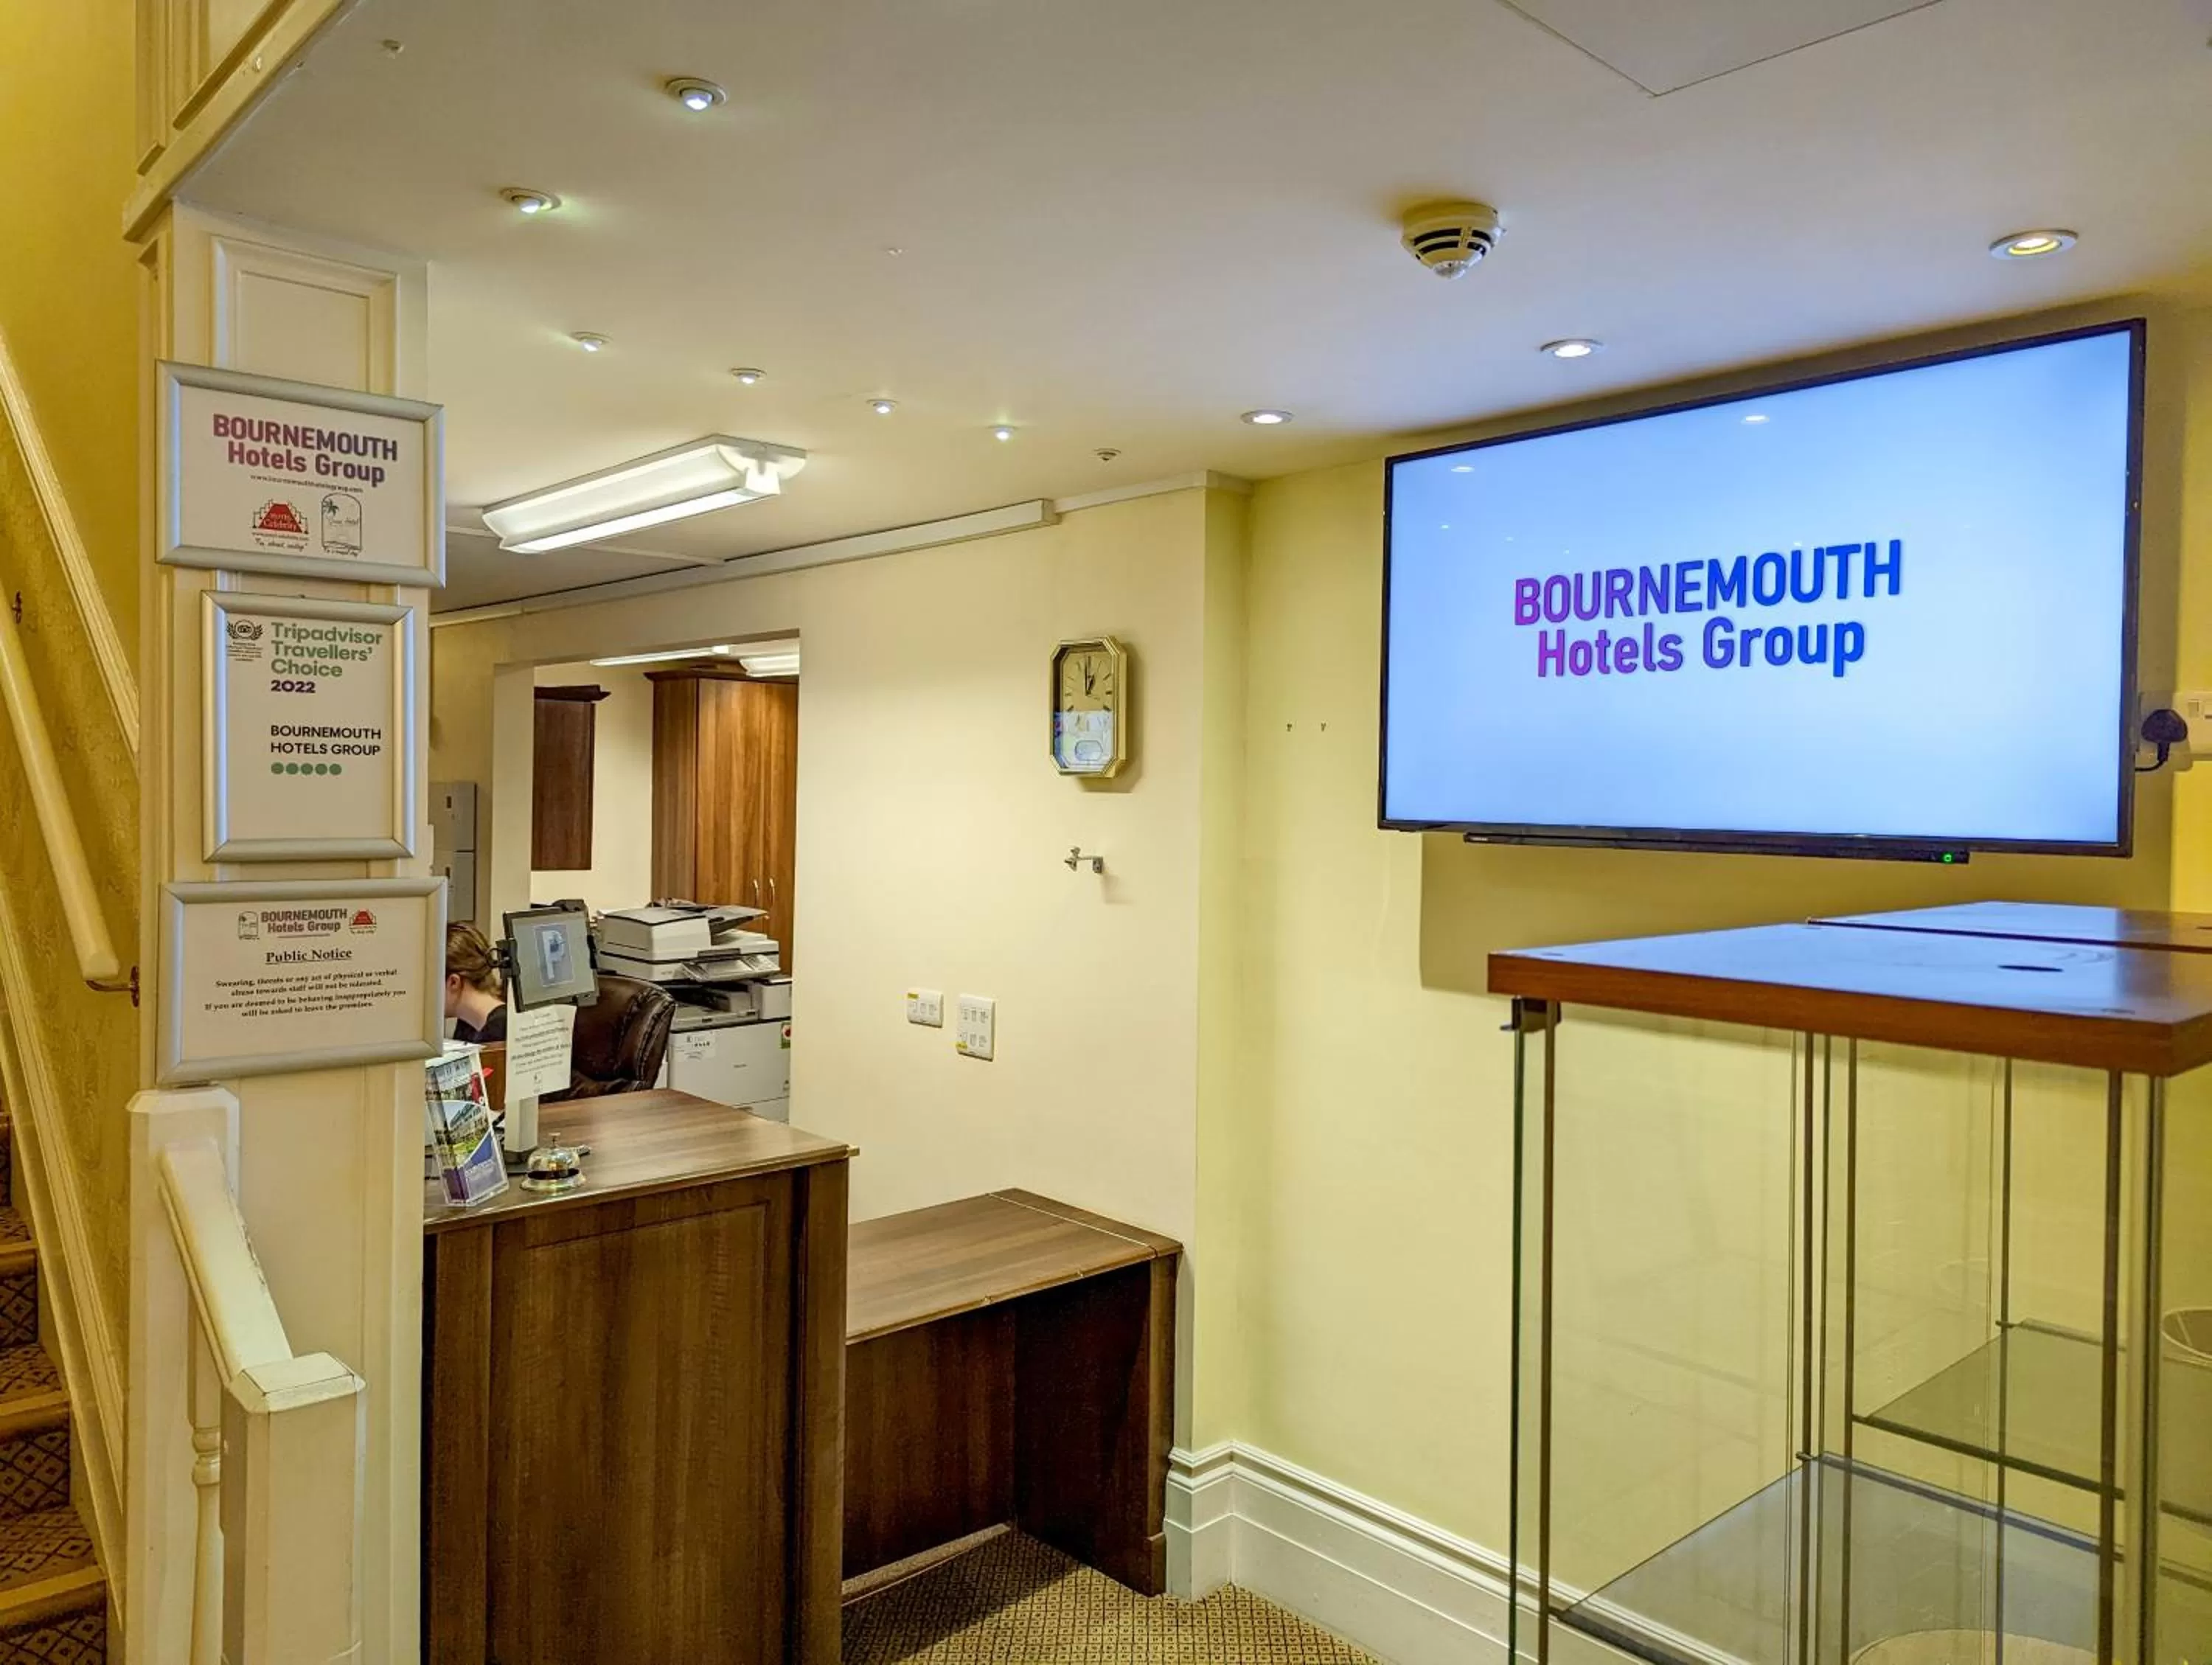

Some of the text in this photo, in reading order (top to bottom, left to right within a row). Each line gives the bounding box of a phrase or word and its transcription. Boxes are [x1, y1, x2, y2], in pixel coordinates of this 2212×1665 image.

[213, 413, 397, 461] BOURNEMOUTH
[228, 441, 385, 487] Hotels Group
[1514, 539, 1901, 625] BOURNEMOUTH
[271, 622, 383, 645] Tripadvisor
[1537, 616, 1865, 677] Hotels Group
[271, 658, 343, 677] Choice
[271, 679, 316, 694] 2022
[270, 725, 381, 740] BOURNEMOUTH
[270, 743, 381, 756] HOTELS GROUP
[260, 908, 347, 922] BOURNEMOUTH
[268, 922, 305, 934] Hotels
[307, 920, 341, 933] Group
[265, 948, 352, 962] Public Notice
